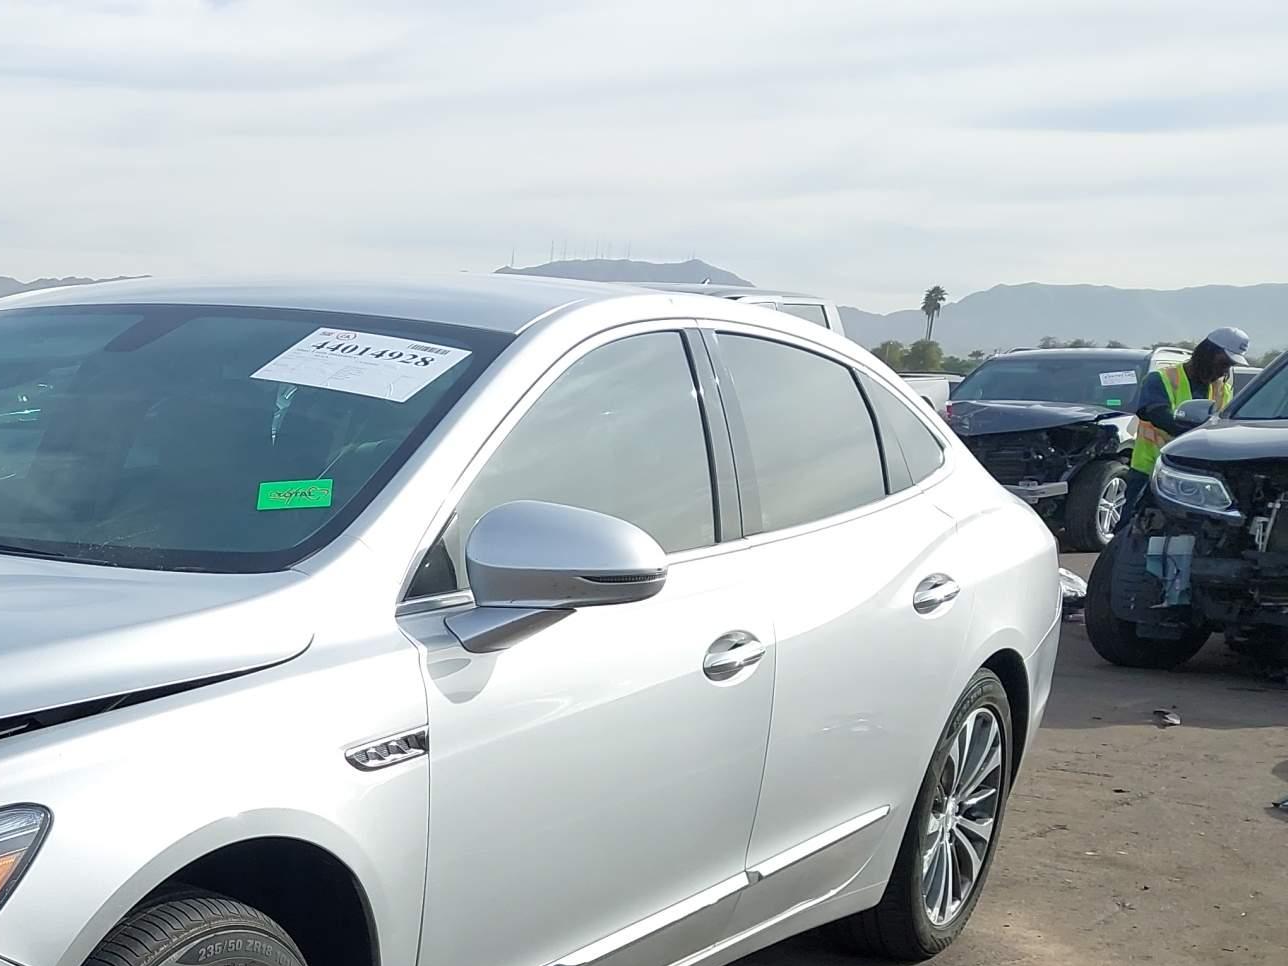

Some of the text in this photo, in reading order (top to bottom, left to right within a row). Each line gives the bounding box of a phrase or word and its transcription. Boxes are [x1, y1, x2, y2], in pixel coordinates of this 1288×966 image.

[311, 341, 435, 367] 44014928
[275, 490, 315, 498] TOTAL
[198, 939, 243, 962] 235/50
[245, 939, 273, 956] ZR18
